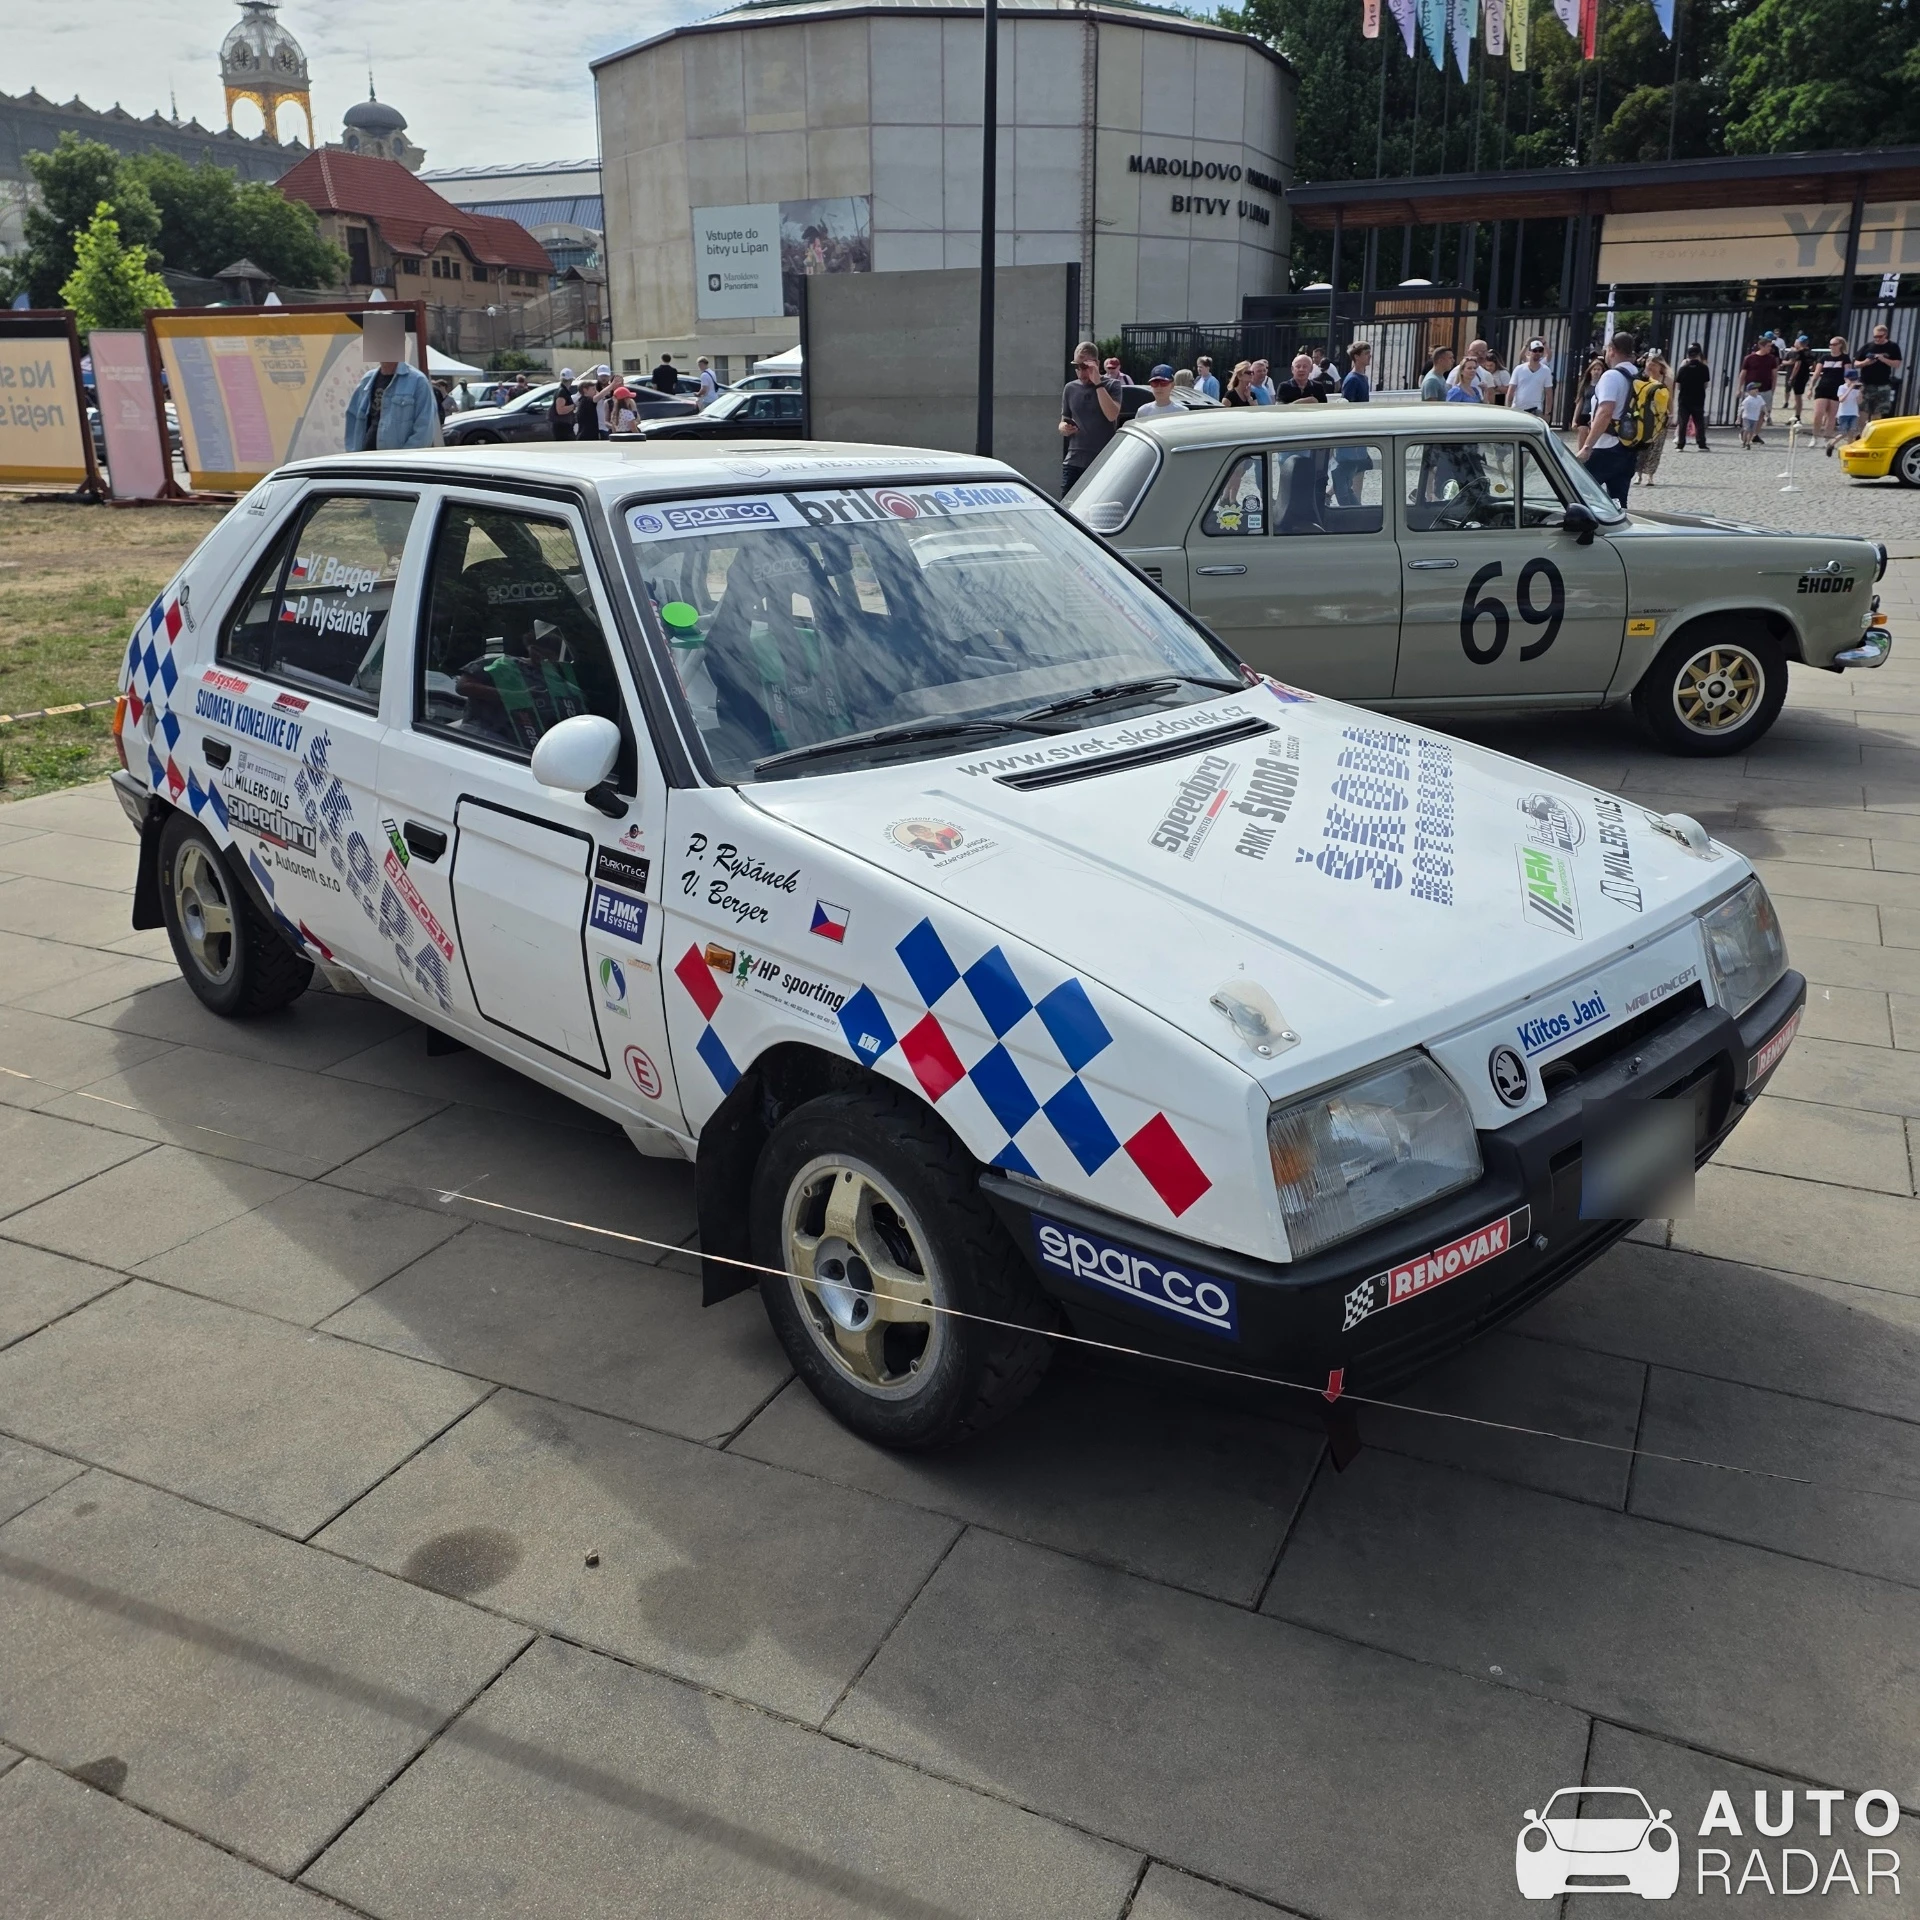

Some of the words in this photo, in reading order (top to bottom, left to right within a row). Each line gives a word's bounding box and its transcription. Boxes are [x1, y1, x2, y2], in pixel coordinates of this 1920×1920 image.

[1129, 155, 1242, 182] MAROLDOVO
[1171, 194, 1231, 216] BITVY
[1238, 199, 1248, 218] U
[706, 230, 743, 243] Vstupte
[745, 228, 759, 239] do
[706, 244, 731, 257] bitvy
[732, 246, 739, 254] u
[740, 242, 769, 255] Lipan
[723, 272, 759, 282] Maroldovo
[668, 503, 774, 527] sparco
[954, 487, 1025, 507] ŠKODA
[307, 551, 321, 583] V.
[321, 554, 381, 598] Berger
[1796, 574, 1855, 594] ŠKODA
[295, 595, 307, 625] P.
[310, 597, 372, 636] Ryšánek
[1460, 557, 1565, 665] 69
[195, 688, 236, 728] SUOMEN
[234, 703, 286, 748] KONELIIKE
[285, 722, 303, 753] OY
[956, 703, 1252, 778] www.svet-skodovek.cz
[235, 773, 269, 801] MILLERS
[270, 789, 290, 810] OILS
[1150, 755, 1230, 853] speedpro
[1229, 757, 1300, 824] ŠKODA
[1295, 726, 1411, 890] ŠKODA
[1593, 797, 1625, 823] OILS
[229, 796, 316, 850] speedpro
[1183, 834, 1201, 860] FOREVER
[1196, 816, 1213, 838] FASTER
[1234, 822, 1277, 861] AMK
[1410, 738, 1455, 906] MOTORSPORT
[275, 851, 318, 884] Autorent
[319, 872, 341, 893] s.r.o
[685, 832, 708, 861] P.
[713, 843, 801, 893] Ryšánek
[1599, 821, 1634, 883] MILLERS
[681, 870, 700, 897] V.
[708, 880, 769, 924] Berger
[1522, 846, 1560, 907] AFM
[608, 915, 639, 934] SYSTEM
[610, 900, 639, 924] JMK
[757, 960, 781, 982] HP
[781, 973, 845, 1013] sporting
[1650, 964, 1697, 1001] CONCEPT
[1517, 1010, 1571, 1051] Kiitos
[1572, 989, 1607, 1026] Jani
[632, 1056, 653, 1089] E
[1039, 1225, 1232, 1328] sparco
[1394, 1224, 1505, 1298] RENOVAK
